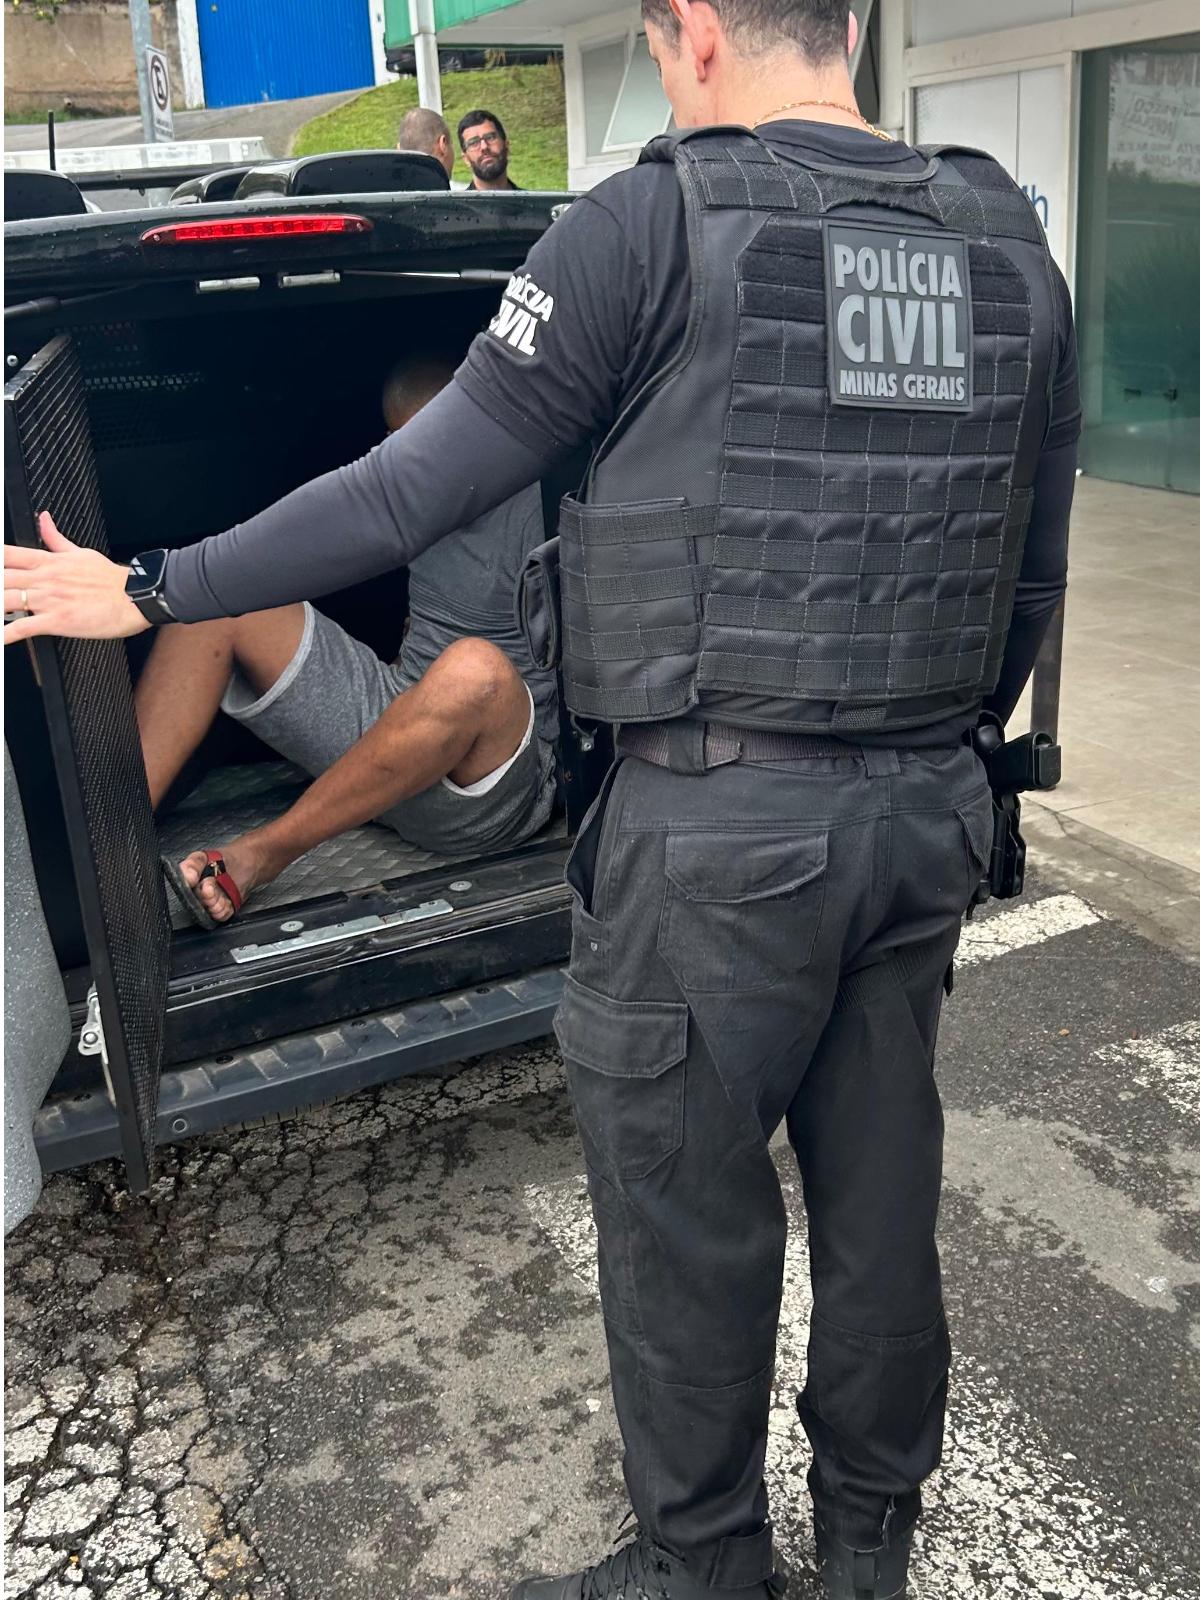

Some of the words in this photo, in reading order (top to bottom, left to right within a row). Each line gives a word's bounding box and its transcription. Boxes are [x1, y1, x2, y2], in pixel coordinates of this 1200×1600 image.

[833, 239, 963, 298] POLÍCIA
[837, 294, 965, 368] CIVIL
[840, 369, 898, 398] MINAS
[903, 373, 965, 401] GERAIS
